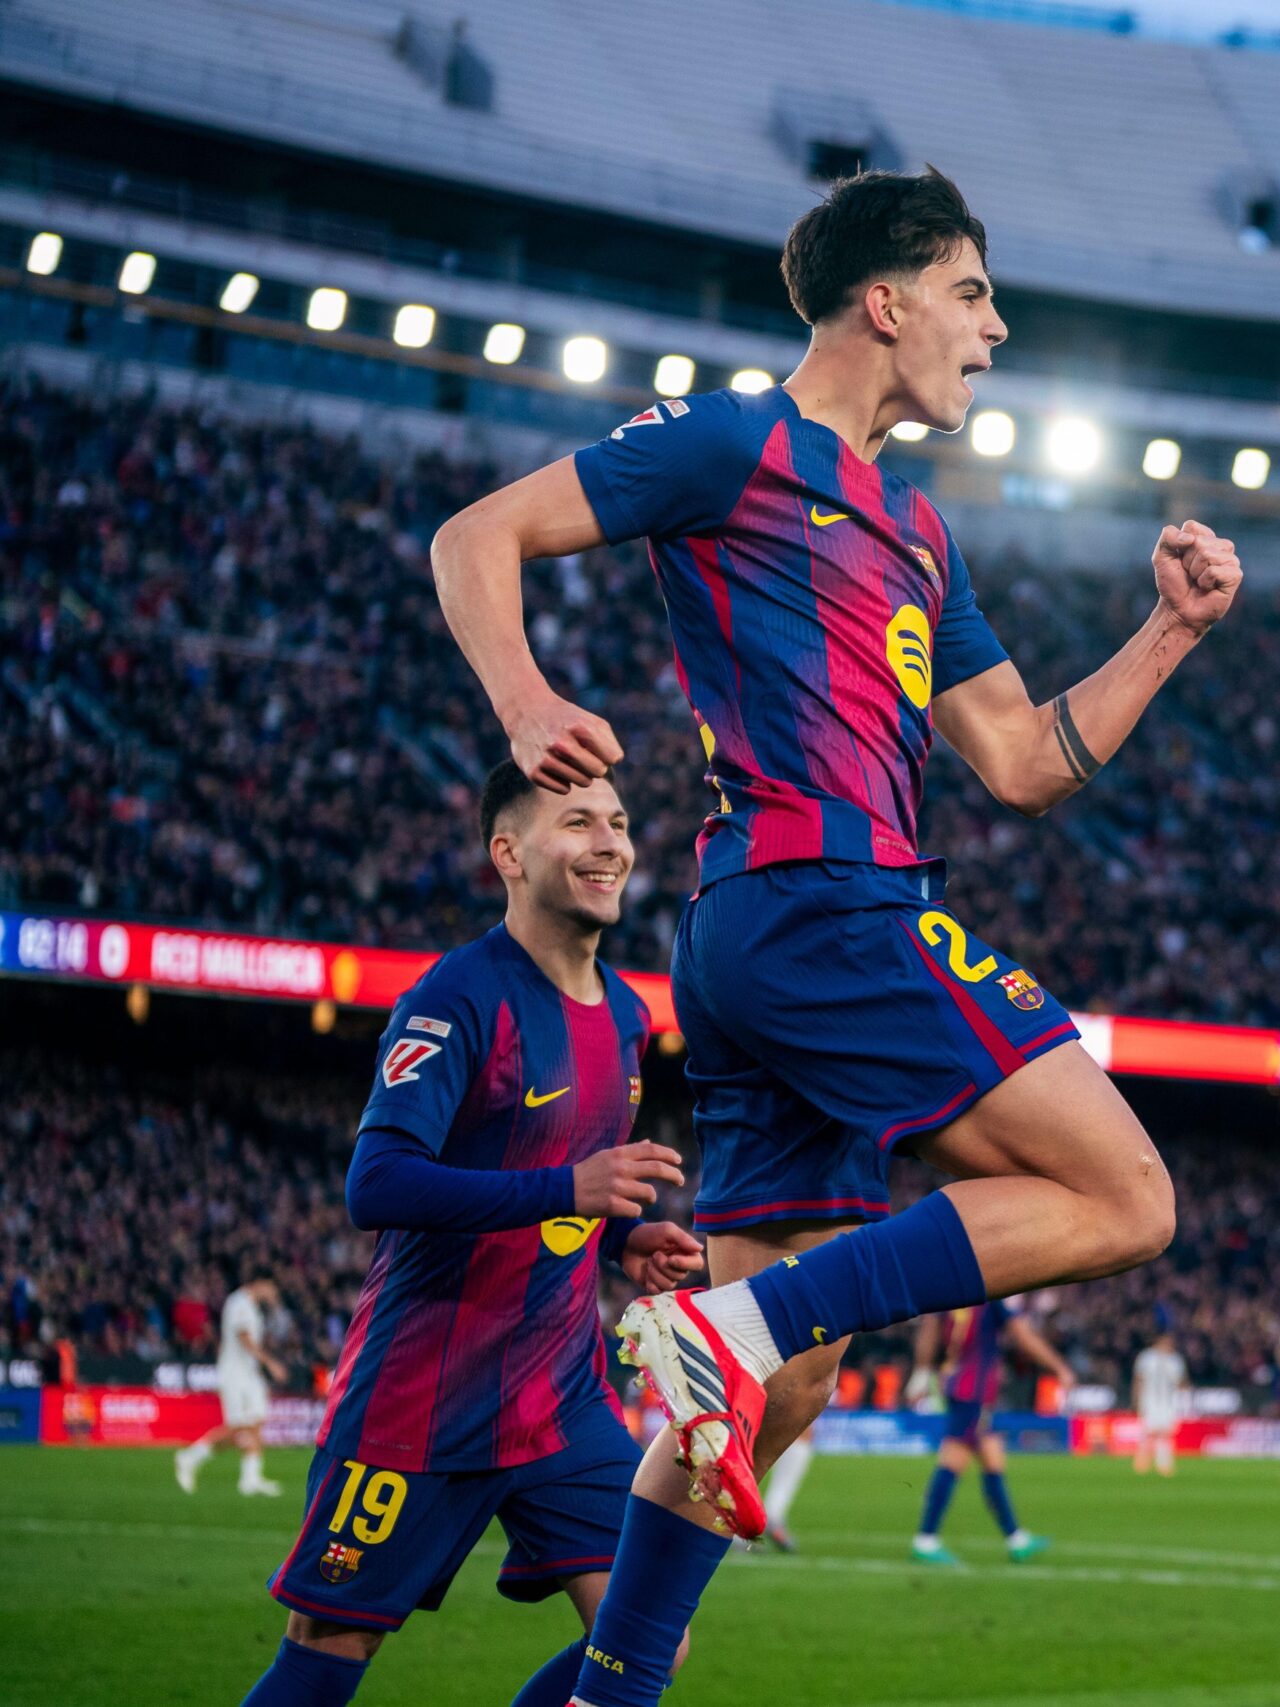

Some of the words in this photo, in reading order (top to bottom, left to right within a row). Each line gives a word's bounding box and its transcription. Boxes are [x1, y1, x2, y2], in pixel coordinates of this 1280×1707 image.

[99, 924, 130, 978] 0
[918, 911, 998, 983] 2
[328, 1460, 408, 1544] 19
